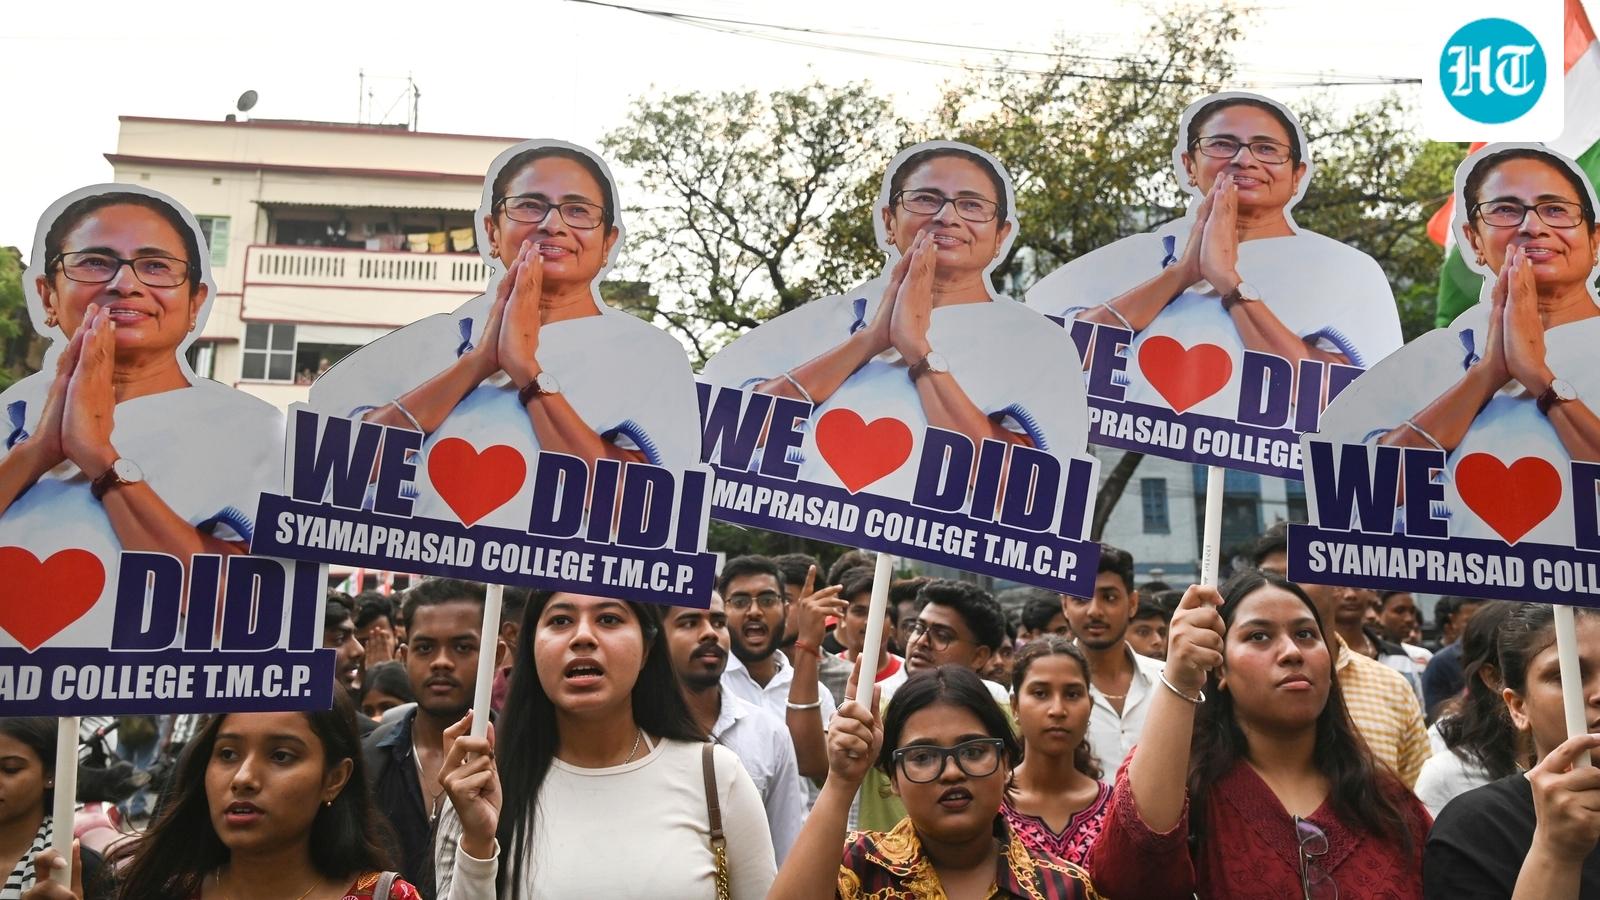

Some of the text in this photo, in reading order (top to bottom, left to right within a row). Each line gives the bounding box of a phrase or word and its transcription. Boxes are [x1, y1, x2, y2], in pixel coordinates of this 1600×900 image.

[1235, 349, 1366, 433] DI
[291, 409, 707, 556] WE DIDI
[696, 382, 1093, 543] WE DIDI
[1088, 406, 1304, 470] PRASAD COLLEGE
[711, 478, 1077, 581] MAPRASAD COLLEGE T.M.C.P.
[1309, 441, 1450, 539] WE
[275, 512, 694, 594] SYAMAPRASAD COLLEGE T.M.C.P.
[1308, 541, 1600, 595] SYAMAPRASAD COLL
[109, 550, 320, 652] DIDI
[51, 665, 195, 700] COLLEGE
[203, 665, 311, 698] T.M.C.P.
